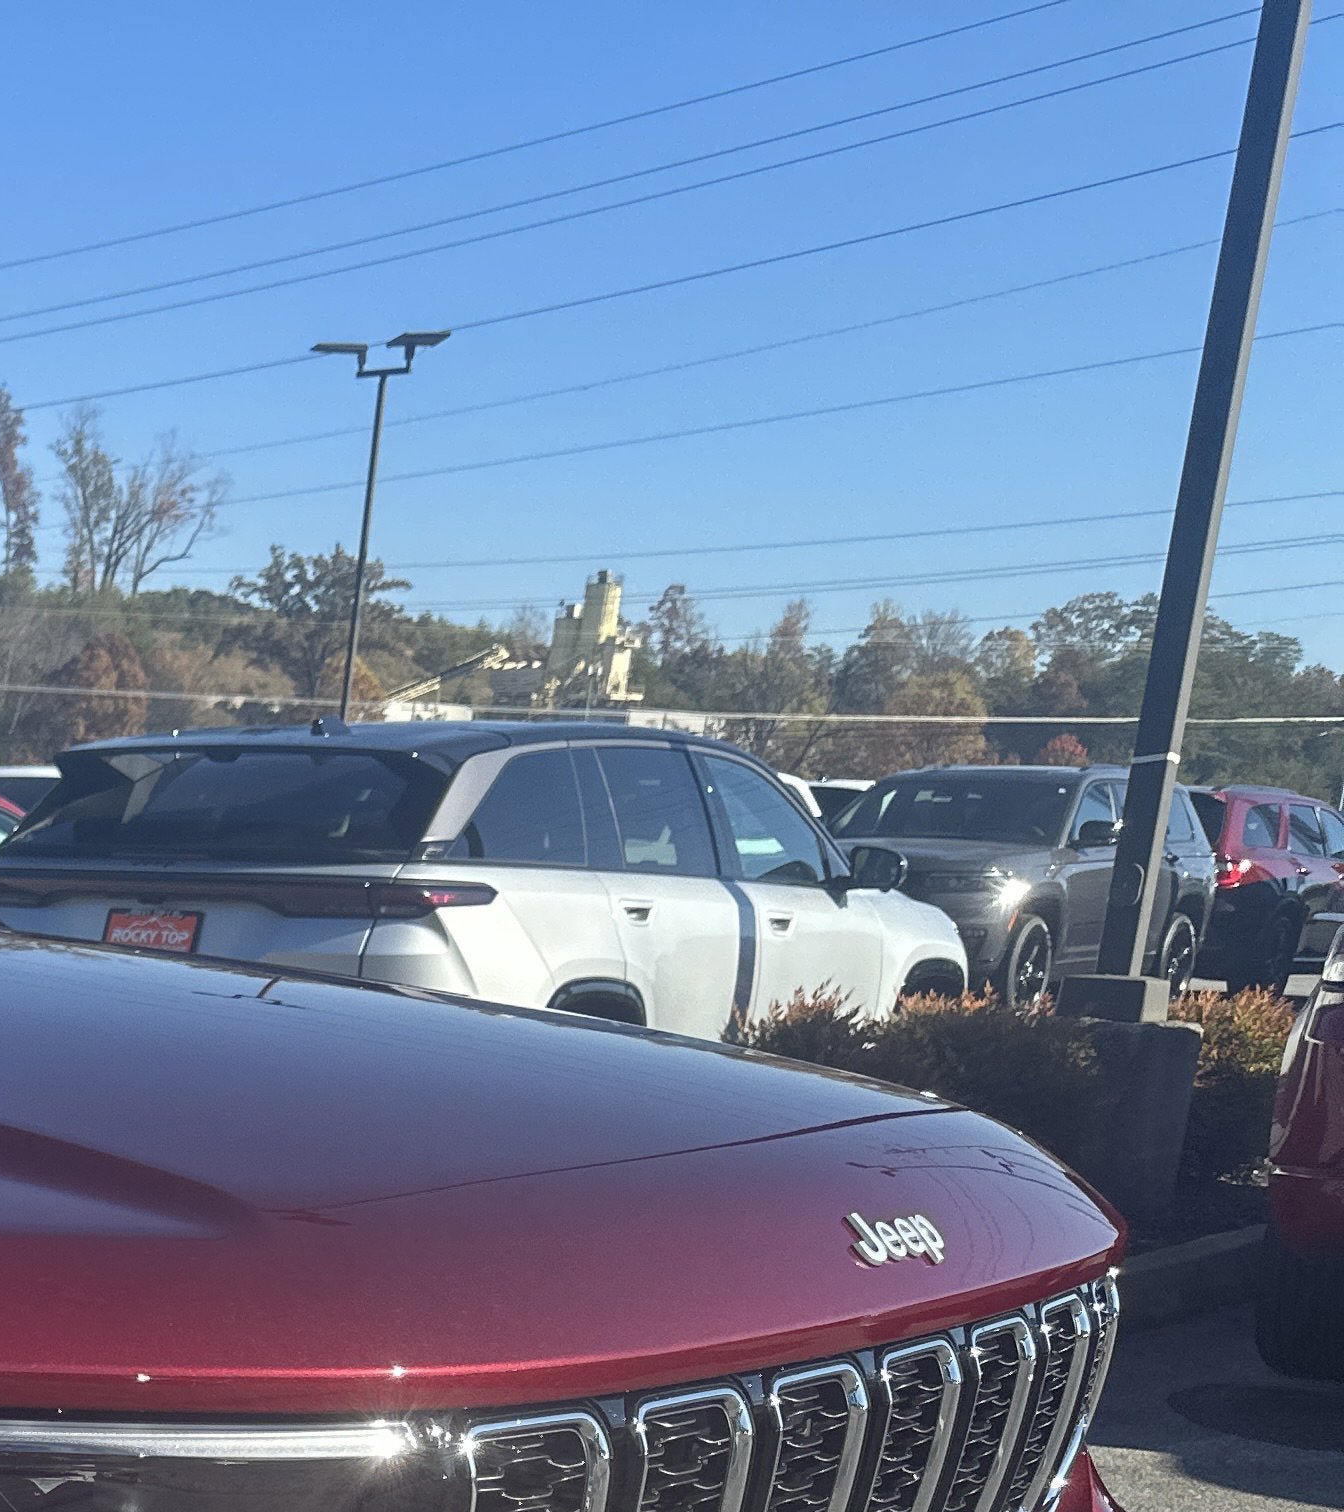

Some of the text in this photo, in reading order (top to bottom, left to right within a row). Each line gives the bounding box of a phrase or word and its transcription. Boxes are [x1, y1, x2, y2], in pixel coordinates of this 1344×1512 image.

[111, 927, 190, 945] ROCKY TOP
[842, 1212, 945, 1267] Jeep
